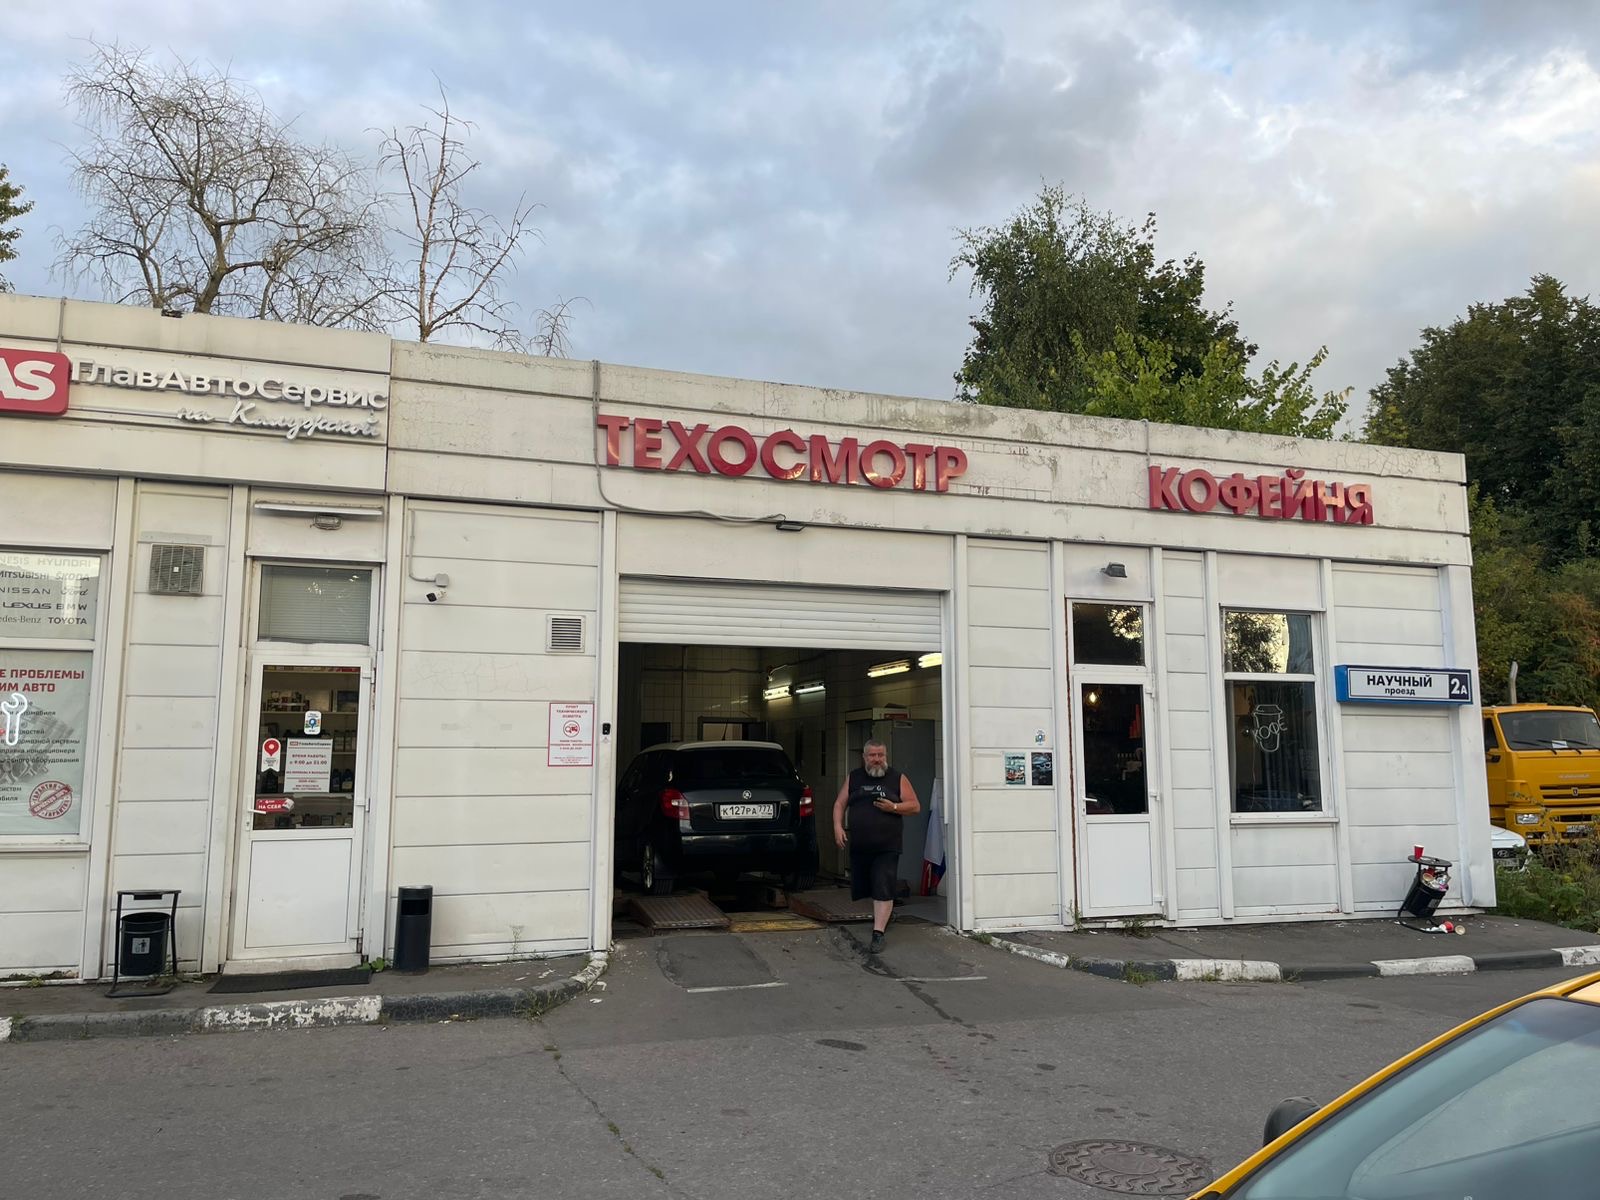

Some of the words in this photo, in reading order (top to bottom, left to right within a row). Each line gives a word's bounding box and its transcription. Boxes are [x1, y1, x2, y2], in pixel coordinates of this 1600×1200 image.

[71, 357, 388, 410] ГлавАвтоСервис
[177, 407, 215, 422] на
[228, 398, 380, 440] Калужской
[597, 414, 968, 493] ТЕХОСМОТР
[1148, 465, 1374, 526] КОФЕЙНЯ
[38, 558, 91, 567] HYUNDAI
[3, 601, 52, 609] LEXUS
[56, 603, 87, 611] BMW
[48, 617, 87, 625] TOYOTA
[10, 669, 85, 680] ПРОБЛЕМЫ
[1367, 675, 1432, 688] НАУЧНЫЙ
[1451, 678, 1468, 695] 2А
[22, 683, 56, 693] АВТО
[1385, 687, 1416, 696] проезд
[1252, 716, 1288, 743] КОФЕ
[722, 805, 757, 816] К127РА
